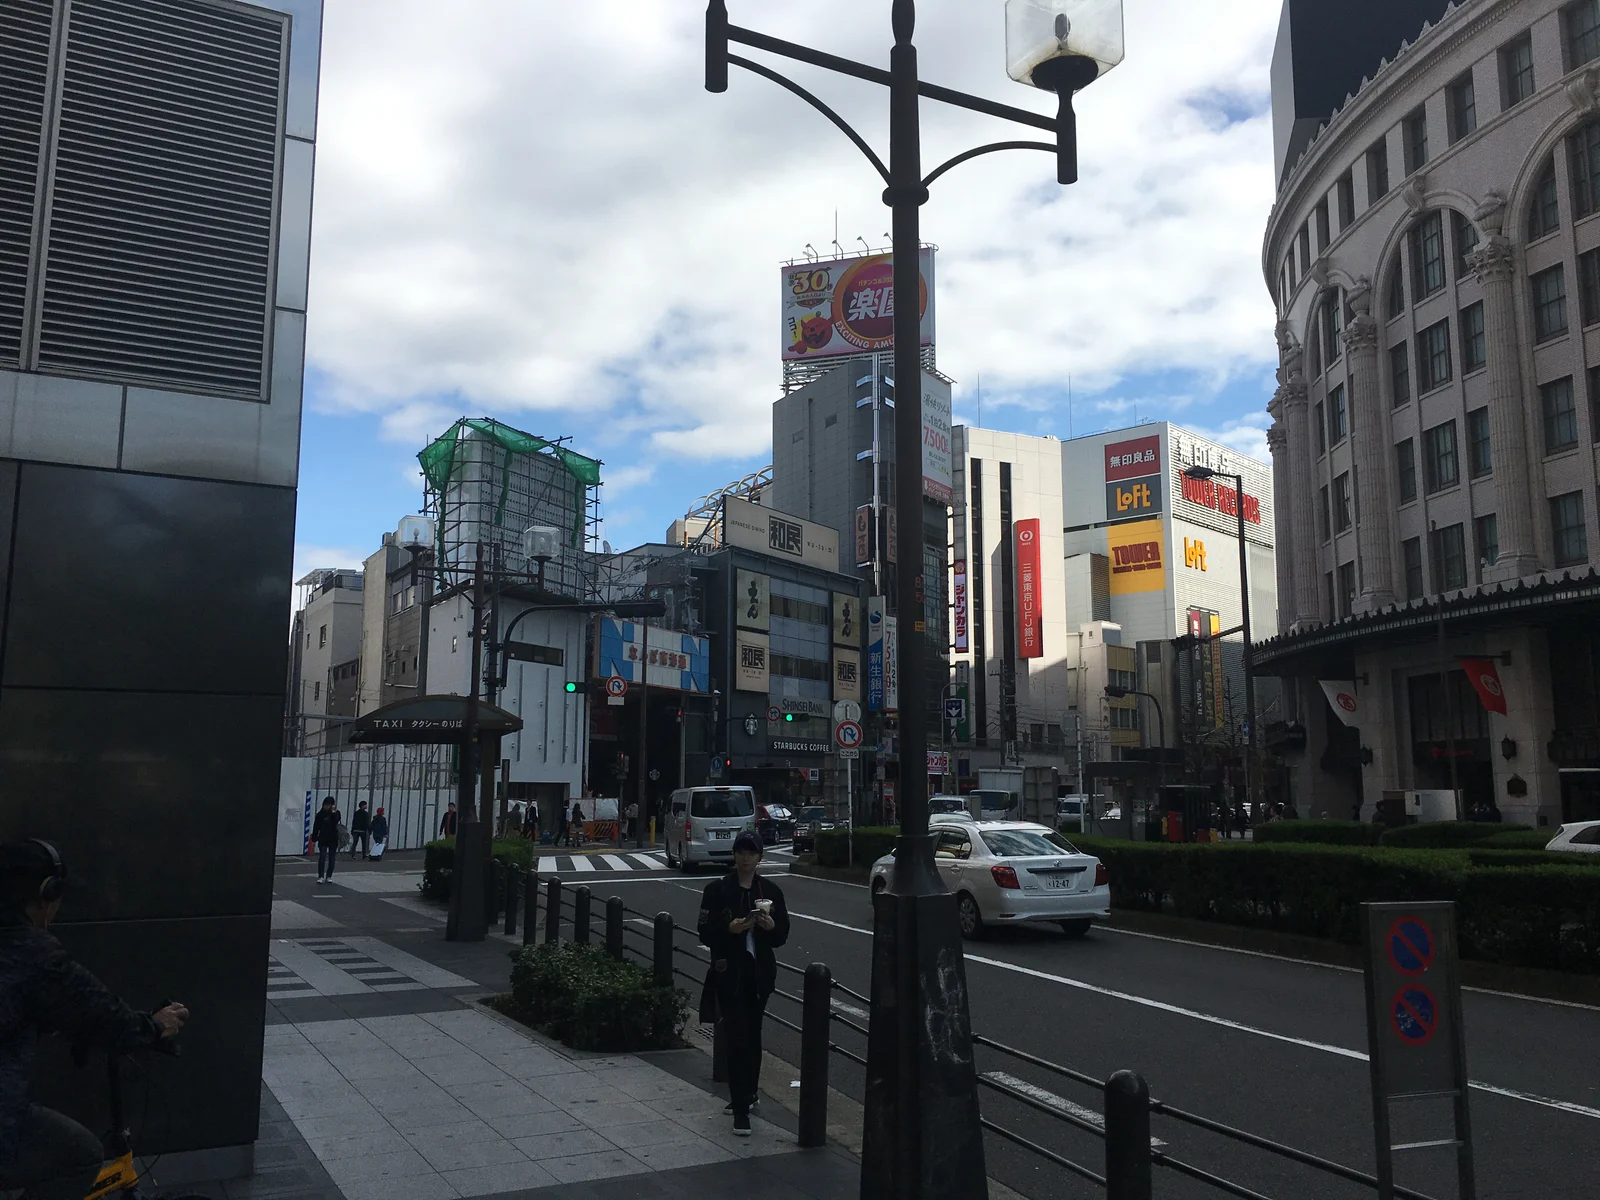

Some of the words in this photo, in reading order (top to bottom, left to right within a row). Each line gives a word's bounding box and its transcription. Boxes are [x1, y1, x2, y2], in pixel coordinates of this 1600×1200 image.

[793, 268, 829, 294] 30
[835, 320, 870, 349] EXCITING
[1109, 449, 1155, 468] 無印良品
[770, 517, 802, 554] 和民
[1112, 541, 1161, 566] TOWER
[955, 583, 966, 638] ジャンカラ
[1022, 563, 1034, 647] 三菱東京UFJ銀行
[869, 652, 882, 704] 新生銀行
[374, 719, 403, 728] TAXI
[411, 719, 439, 728] タクシー
[773, 741, 808, 751] STARBUCKS
[809, 743, 830, 752] COFFEE
[1052, 879, 1070, 888] 12-47
